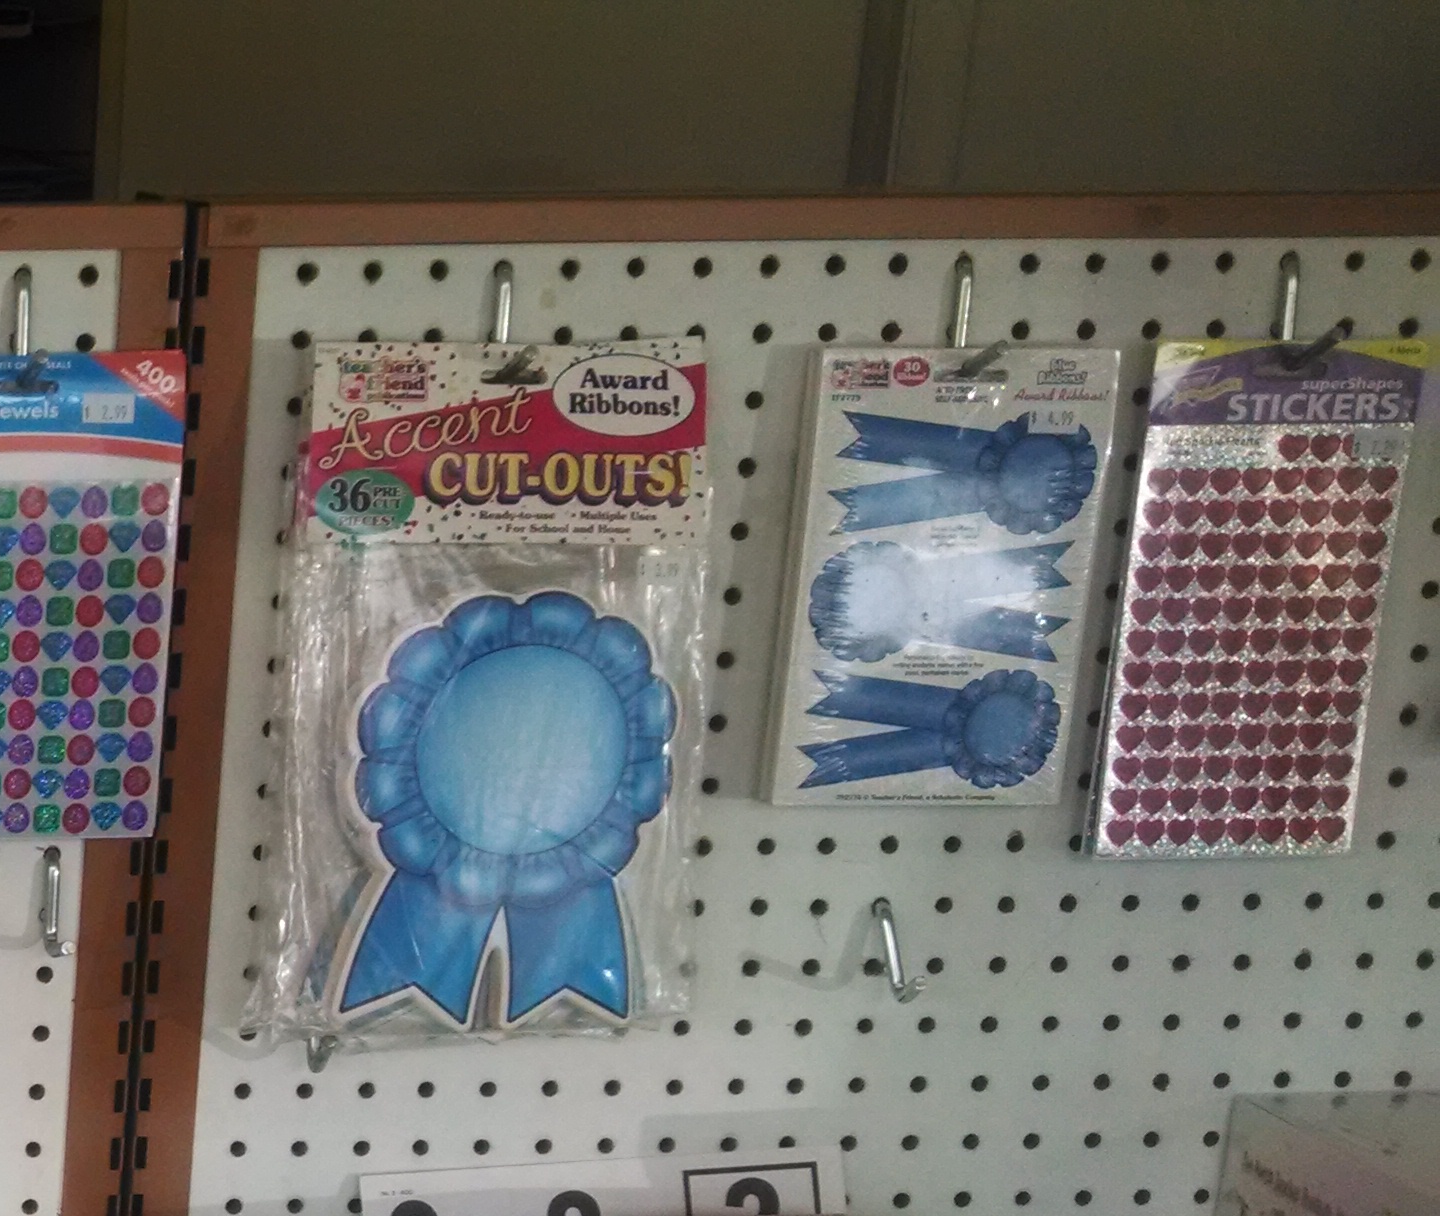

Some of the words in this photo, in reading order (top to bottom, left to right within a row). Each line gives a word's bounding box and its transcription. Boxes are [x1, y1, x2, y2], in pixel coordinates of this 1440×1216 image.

[136, 359, 177, 395] 400
[579, 367, 670, 392] Award
[1301, 376, 1404, 391] superShapes
[567, 393, 682, 418] Ribbons!
[1226, 392, 1402, 422] STICKERS
[318, 385, 533, 470] Accent
[426, 450, 693, 505] CUT-OUTS!
[327, 477, 374, 513] 36
[373, 487, 402, 498] PRE
[373, 498, 402, 510] CUT
[505, 524, 527, 534] For
[529, 523, 570, 534] School
[572, 523, 595, 534] and
